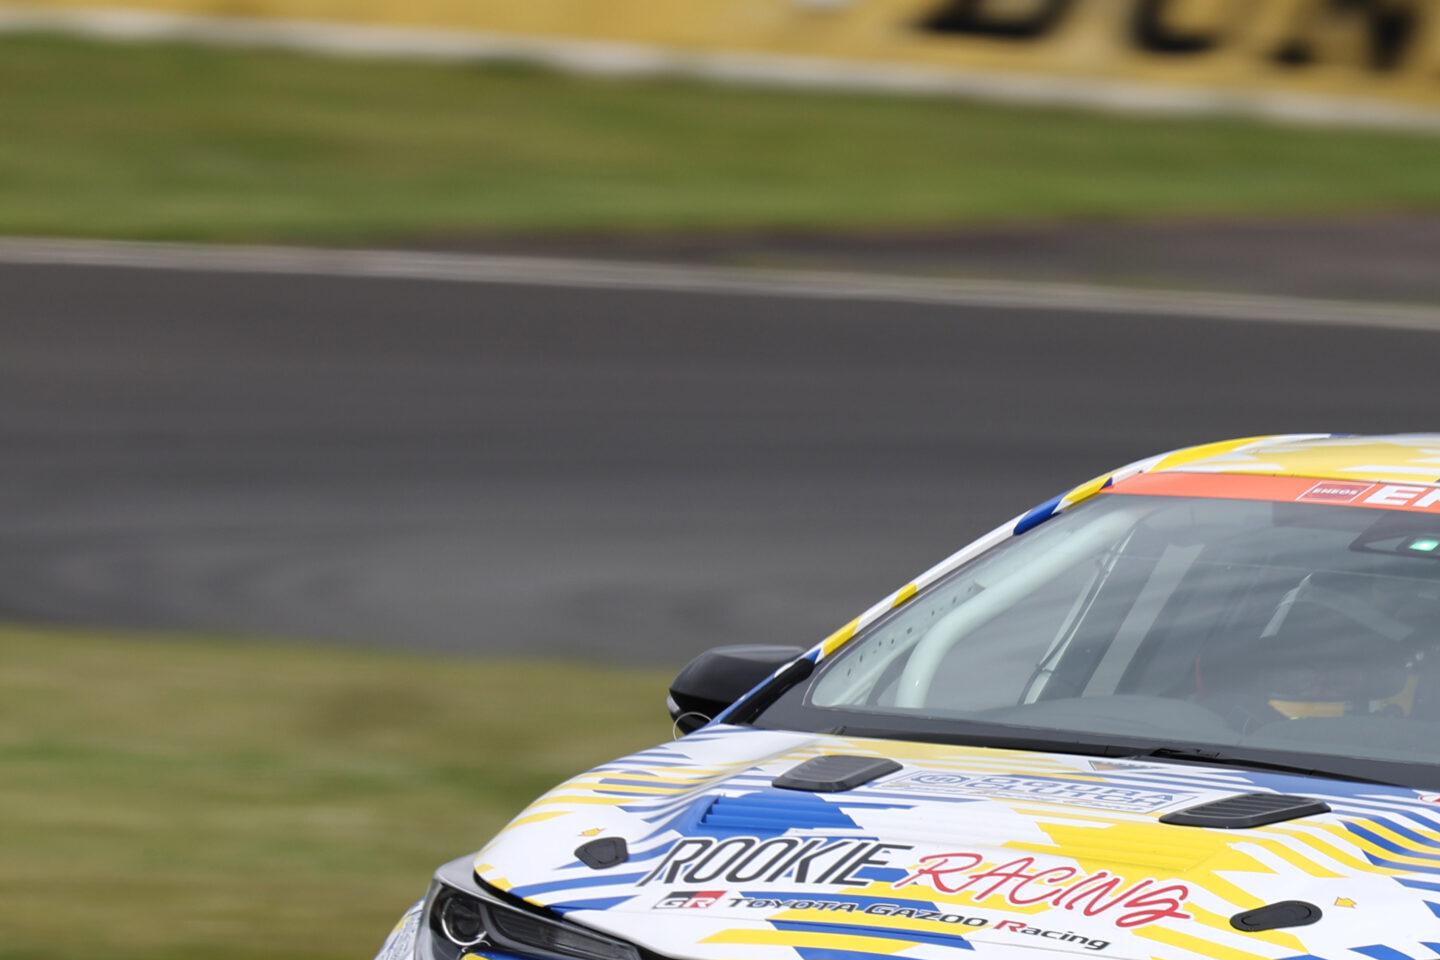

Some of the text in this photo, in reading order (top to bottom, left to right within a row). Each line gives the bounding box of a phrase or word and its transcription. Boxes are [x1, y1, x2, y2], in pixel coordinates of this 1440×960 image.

[1313, 486, 1359, 496] ENEOS
[638, 838, 1195, 929] ROOKIE RACING
[654, 895, 719, 909] GR
[728, 896, 1112, 950] TOYOTA GAZOO Racing
